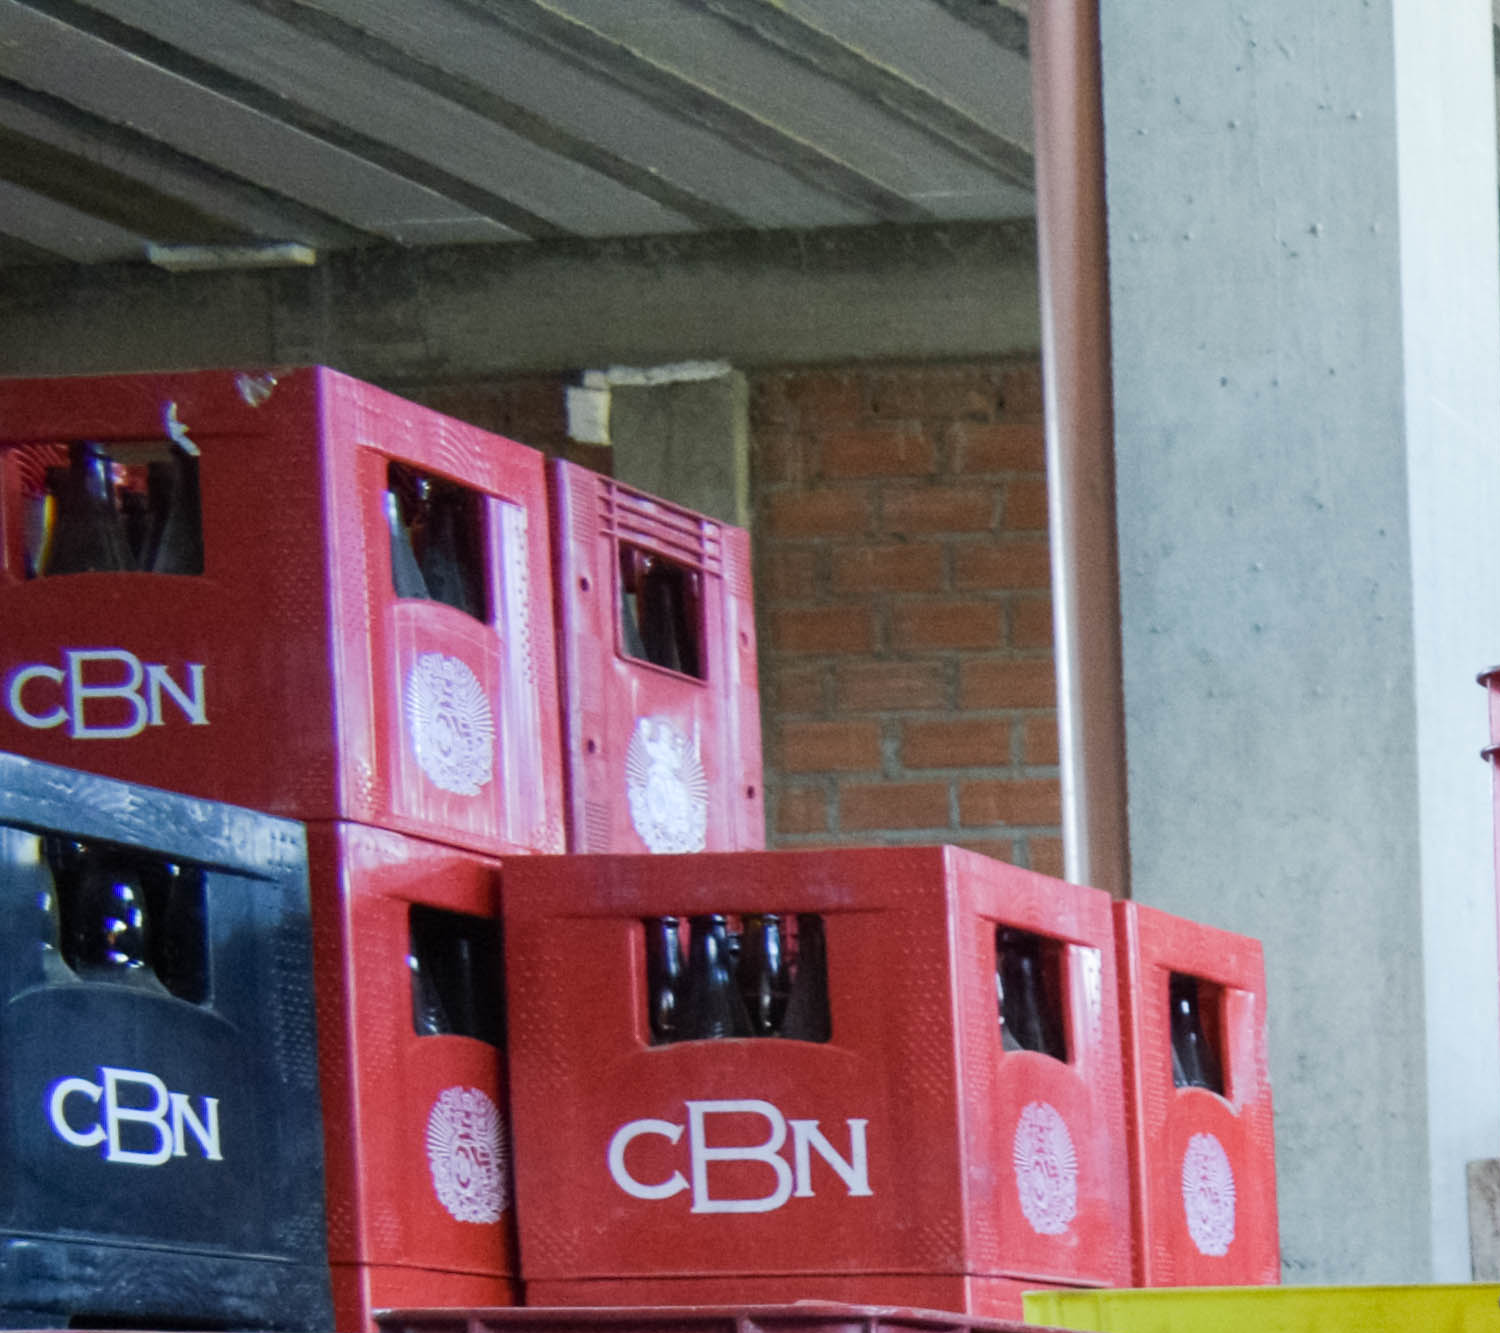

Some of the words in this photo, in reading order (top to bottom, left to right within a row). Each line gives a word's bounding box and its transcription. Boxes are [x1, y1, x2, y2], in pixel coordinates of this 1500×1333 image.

[9, 649, 211, 740] CBN
[48, 1066, 223, 1166] CBN
[608, 1099, 875, 1214] CBN
